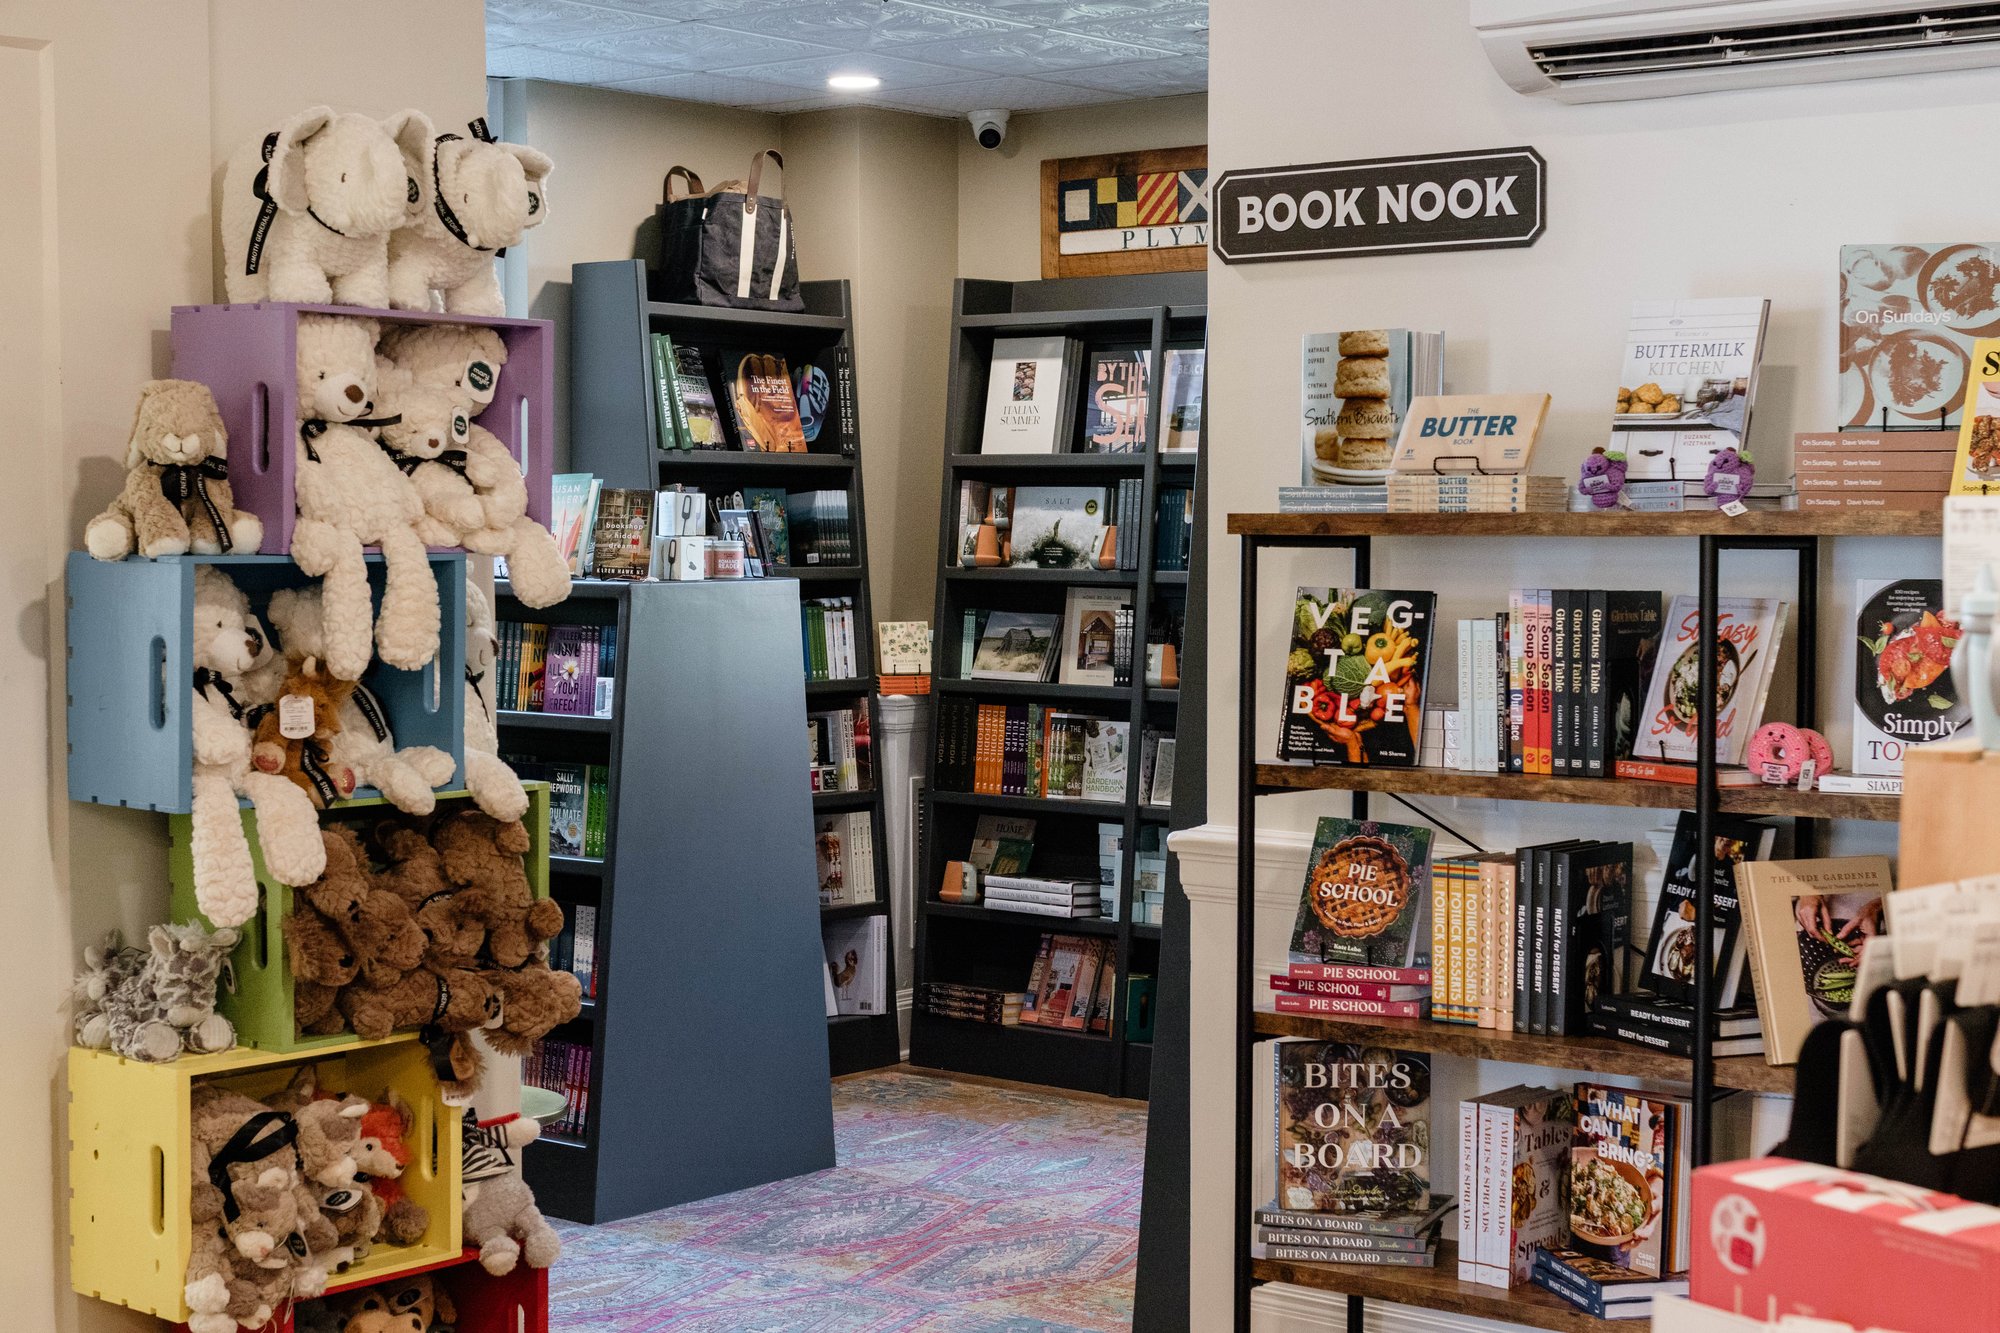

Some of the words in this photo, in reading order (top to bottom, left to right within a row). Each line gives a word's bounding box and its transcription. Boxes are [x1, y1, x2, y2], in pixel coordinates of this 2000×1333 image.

[1237, 187, 1366, 234] BOOK
[1376, 175, 1519, 224] NOOK
[255, 215, 270, 243] GENERAL
[1856, 310, 1878, 324] On
[1882, 310, 1951, 326] Sundays
[1634, 342, 1745, 359] BUTTERMILK
[473, 367, 490, 379] mary
[751, 375, 765, 384] The
[766, 376, 787, 386] Finest
[1096, 362, 1117, 382] BY
[1648, 360, 1726, 376] KITCHEN
[771, 386, 790, 394] Field
[1000, 416, 1041, 426] SUMMER
[1093, 383, 1147, 445] SEA
[1304, 407, 1352, 426] Southern
[1352, 406, 1400, 426] Biscuits
[1420, 415, 1518, 438] BUTTER
[1453, 438, 1474, 446] BOOK
[1045, 496, 1072, 504] SALT
[1439, 496, 1467, 504] BUTTER
[606, 522, 644, 531] bookshop
[614, 532, 641, 540] hidden
[1525, 624, 1536, 658] Soup
[1540, 626, 1552, 660] Soup
[1556, 608, 1565, 658] Glorious
[1572, 609, 1583, 658] Glorious
[1592, 609, 1602, 659] Glorious
[1526, 662, 1536, 712] Season
[1542, 664, 1552, 714] Season
[1556, 660, 1565, 693] Table
[1572, 662, 1582, 694] Table
[1590, 662, 1601, 694] Table
[1884, 712, 1960, 742] Simply
[556, 772, 574, 782] SALLY
[550, 808, 581, 820] OULMATE
[1348, 863, 1378, 881] PIE
[1796, 874, 1819, 882] SIDE
[1823, 871, 1877, 881] GARDENER
[1320, 882, 1398, 907] SCHOOL
[1435, 891, 1445, 941] POTLUCK
[1451, 892, 1461, 942] POTLUCK
[1466, 893, 1477, 943] POTLUCK
[1536, 907, 1544, 937] READY
[1554, 908, 1562, 938] READY
[1323, 967, 1343, 978] PIE
[1346, 968, 1400, 981] SCHOOL
[1434, 945, 1445, 1000] DESSERTS
[1451, 946, 1461, 1000] DESSERTS
[1466, 947, 1477, 1003] DESSERTS
[1516, 950, 1525, 991] DESSERT
[1534, 952, 1543, 994] DESSERT
[1552, 953, 1560, 995] DESSERT
[1298, 980, 1315, 990] PIE
[1317, 981, 1362, 996] SCHOOL
[1309, 999, 1329, 1010] PIE
[1332, 1000, 1386, 1013] SCHOOL
[1630, 1010, 1651, 1020] READY
[1651, 1014, 1661, 1022] for
[1661, 1016, 1690, 1028] DESSERT
[1618, 1028, 1635, 1039] READY
[1636, 1033, 1644, 1041] for
[1644, 1035, 1670, 1048] DESSERT
[1304, 1063, 1411, 1089] BITES
[1314, 1103, 1367, 1129] ON
[1378, 1104, 1401, 1129] A
[1597, 1098, 1641, 1125] WHAT
[1464, 1114, 1472, 1163] TABLES
[1484, 1115, 1492, 1163] TABLES
[1524, 1126, 1569, 1153] Tables
[1580, 1115, 1615, 1136] CAN
[1616, 1123, 1621, 1139] I
[1293, 1143, 1422, 1168] BOARD
[1597, 1142, 1654, 1169] BRING?
[1539, 1179, 1550, 1199] &
[1482, 1177, 1490, 1233] SPREADS
[1498, 1180, 1506, 1237] SPREADS
[1263, 1214, 1294, 1225] BITES
[1296, 1216, 1314, 1226] ON
[1315, 1218, 1324, 1227] A
[1324, 1219, 1363, 1230] BOARD
[1268, 1232, 1301, 1243] BITES
[1303, 1235, 1322, 1245] ON
[1323, 1236, 1331, 1245] A
[1332, 1237, 1372, 1247] BOARD
[1275, 1248, 1308, 1259] BITES
[1311, 1250, 1329, 1260] ON
[1330, 1251, 1339, 1261] A
[1340, 1252, 1380, 1263] BOARD
